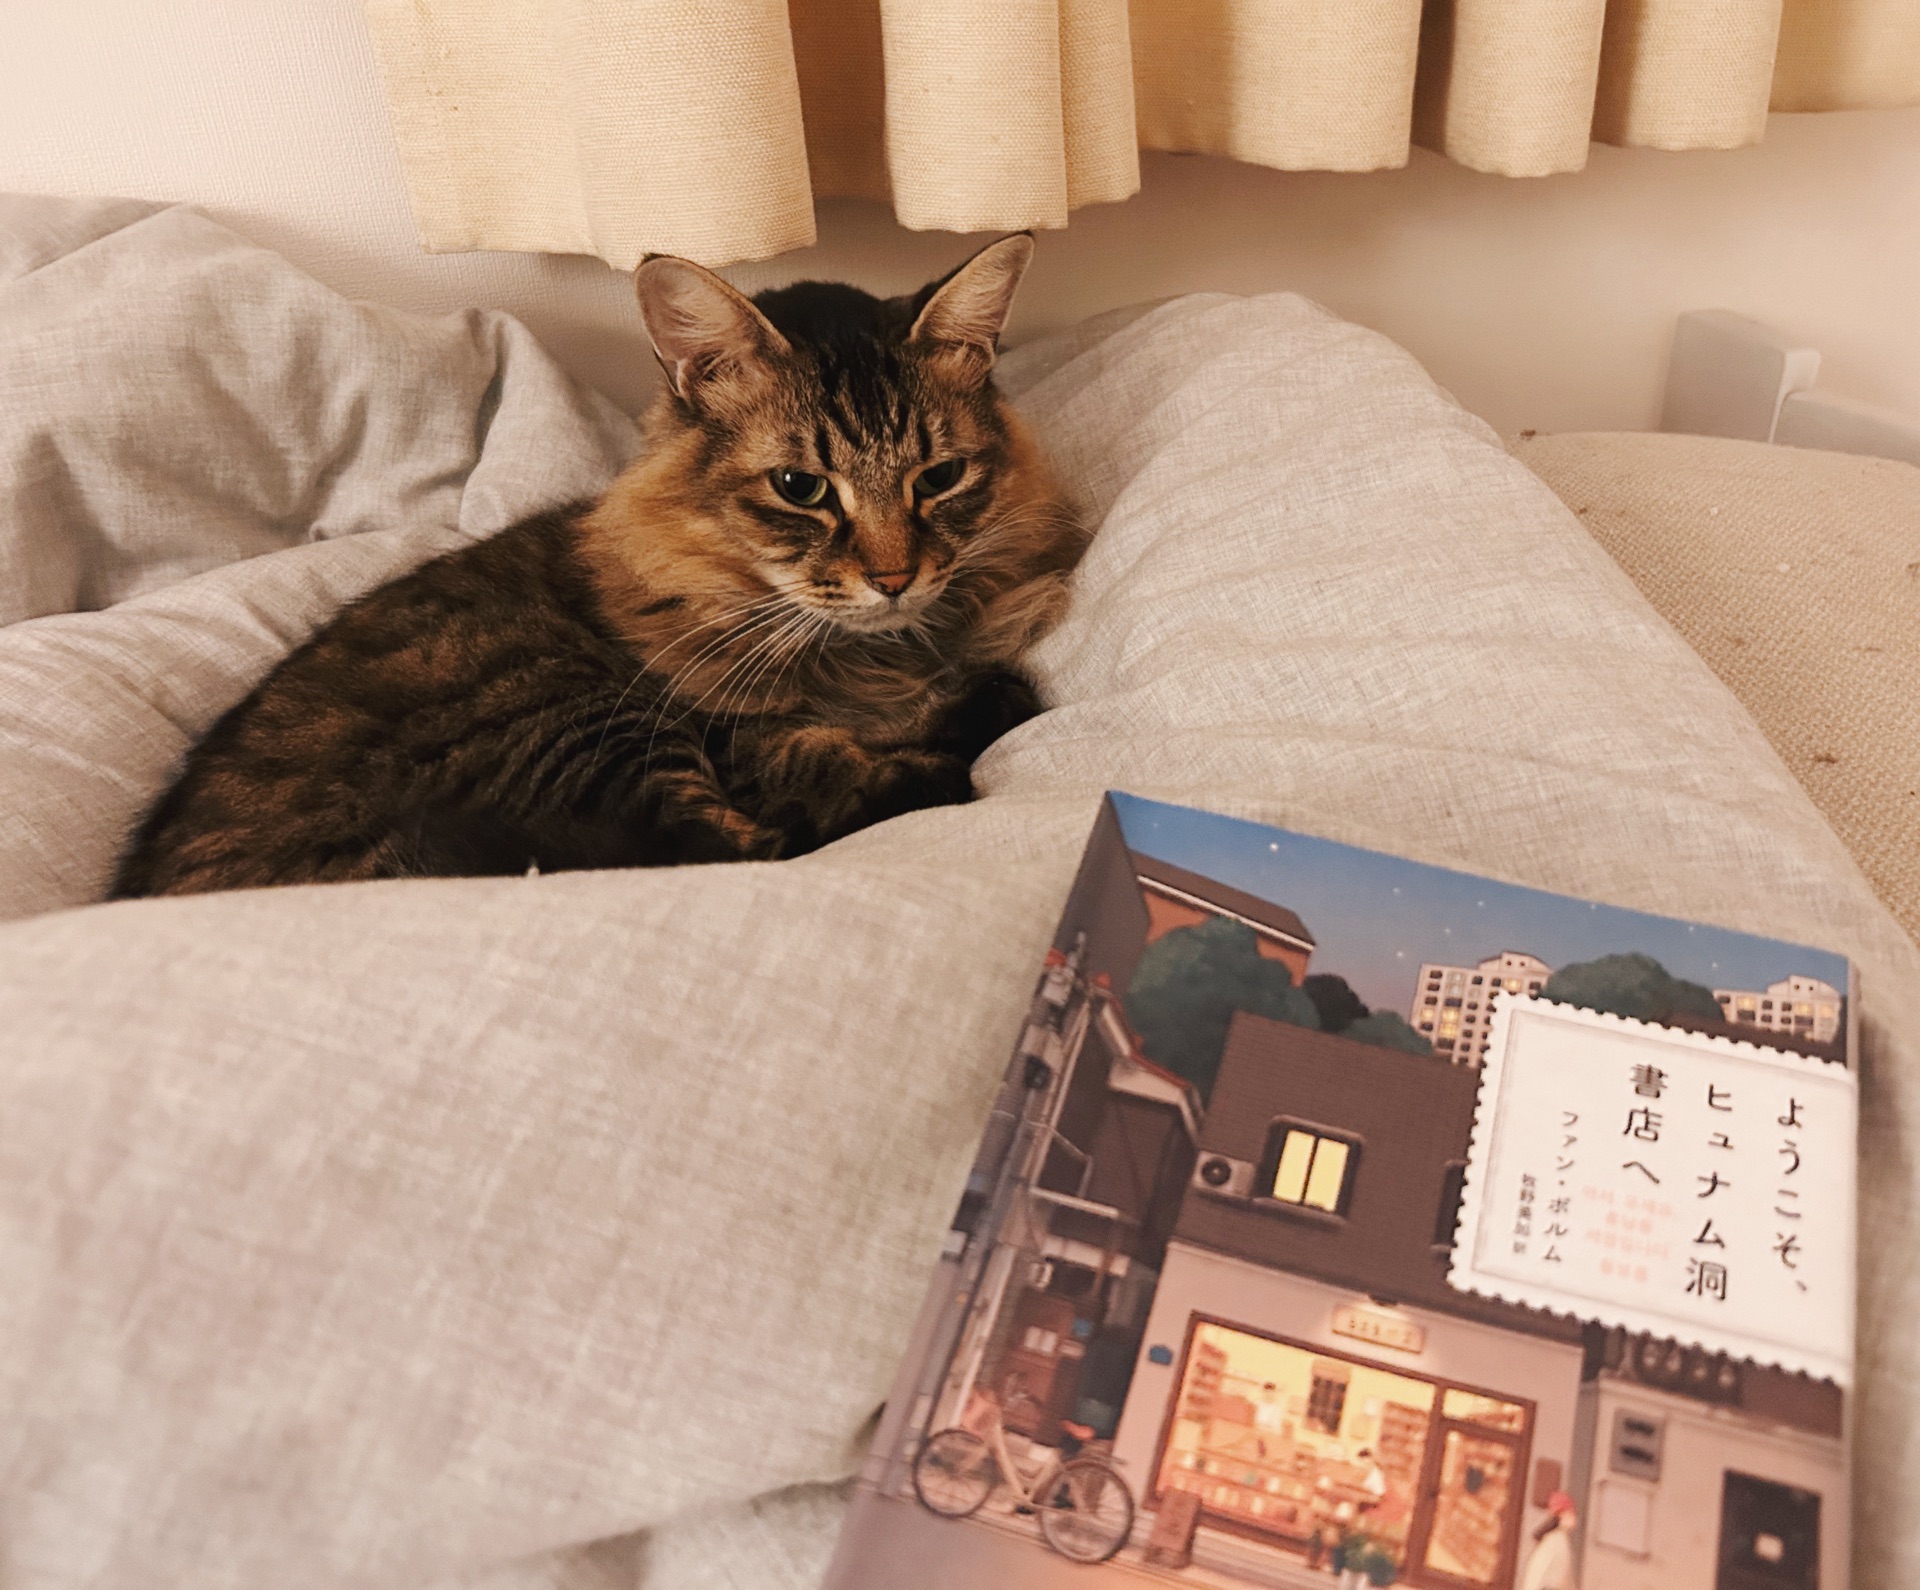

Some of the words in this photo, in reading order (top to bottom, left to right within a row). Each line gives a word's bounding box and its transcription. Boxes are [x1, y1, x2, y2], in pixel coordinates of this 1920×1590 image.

[1622, 1063, 1669, 1185] 書店へ
[1685, 1083, 1734, 1302] ヒュナム洞
[1773, 1096, 1808, 1292] ようこそ、
